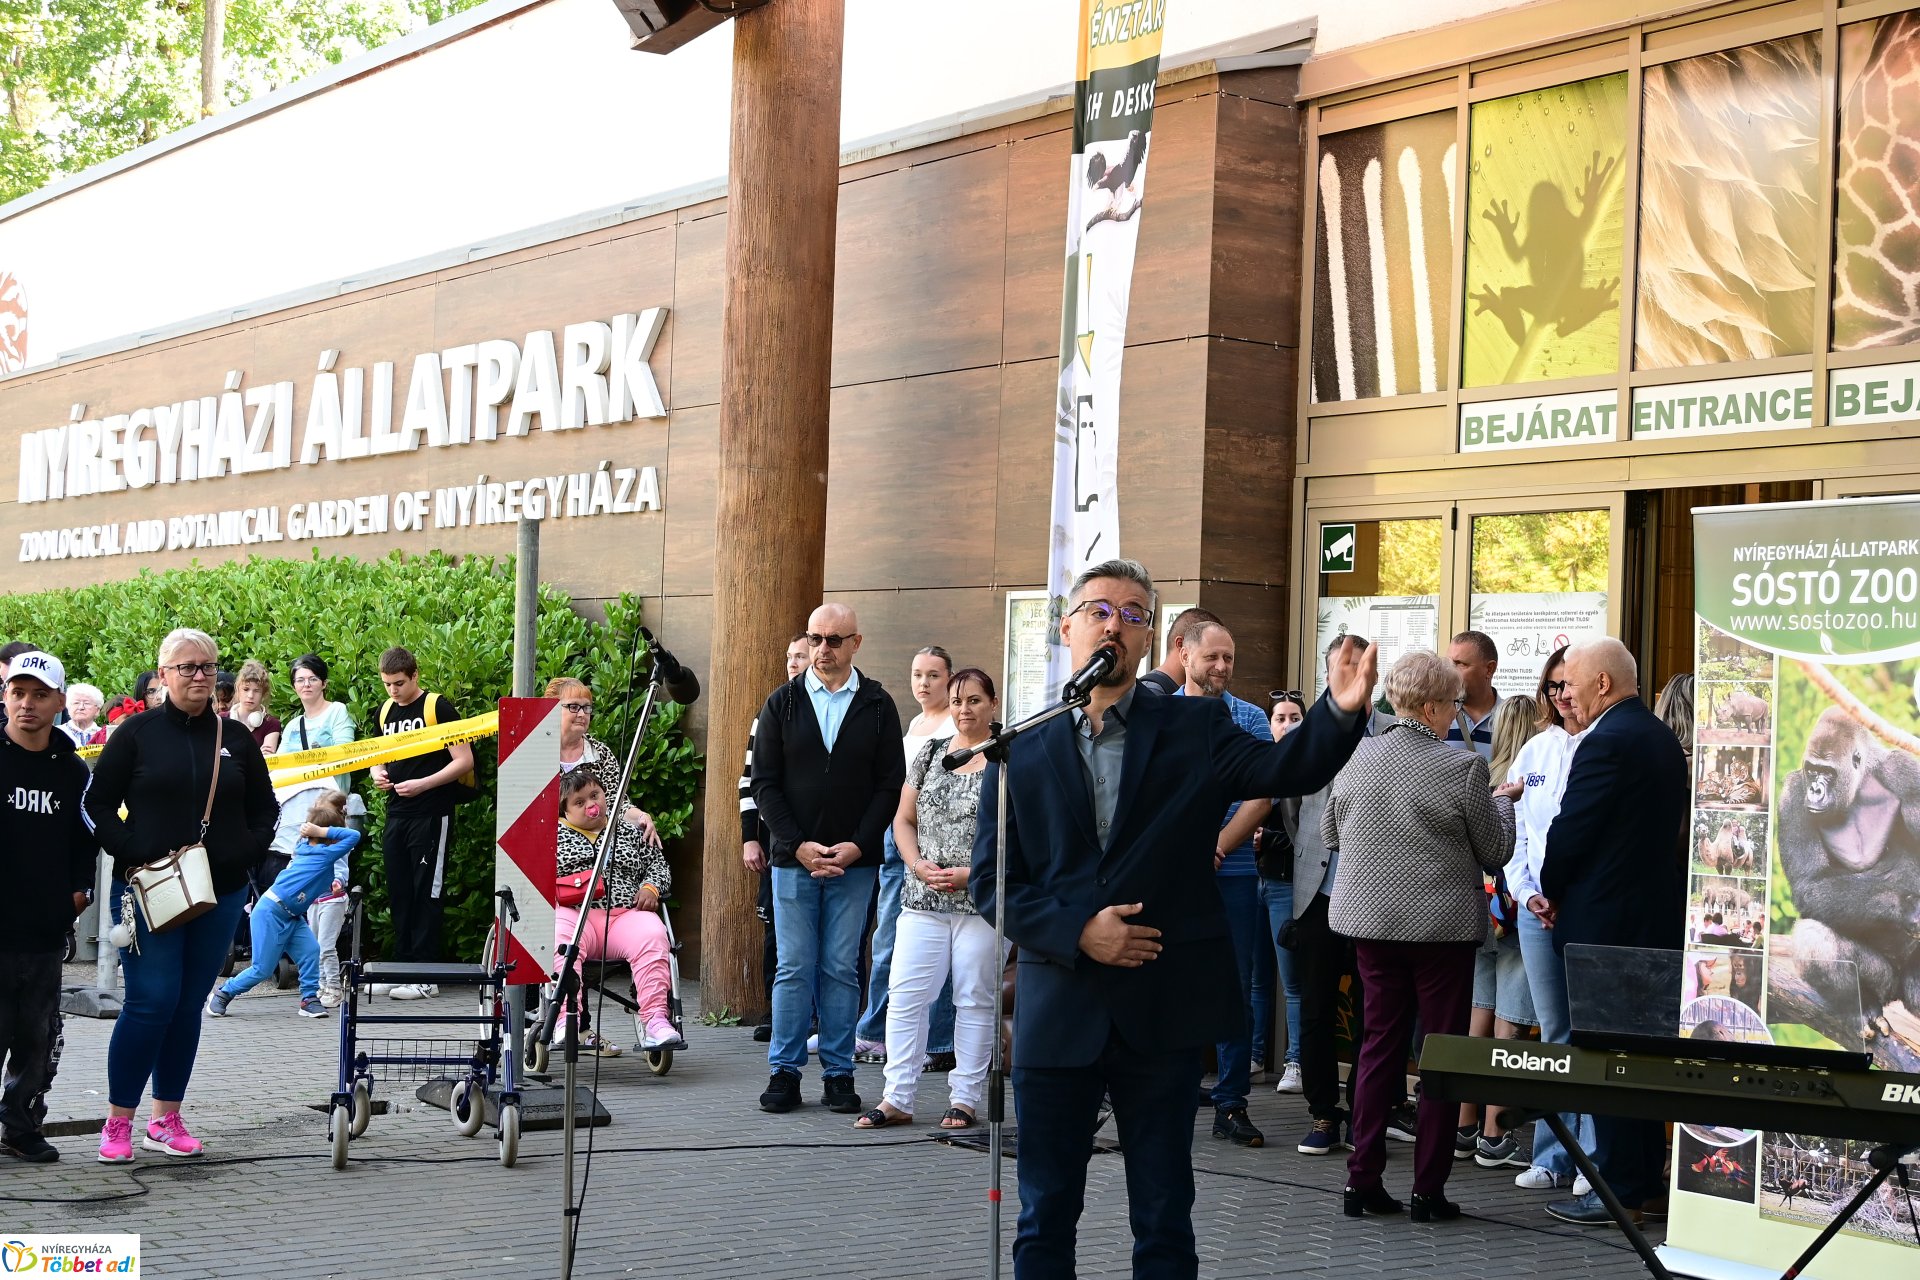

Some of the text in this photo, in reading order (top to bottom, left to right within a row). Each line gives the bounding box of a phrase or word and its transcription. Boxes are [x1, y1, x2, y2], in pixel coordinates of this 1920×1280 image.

[18, 306, 670, 503] NYÍREGYHÁZI ÁLLATPARK
[1464, 402, 1617, 446] BEJÁRAT
[1634, 387, 1813, 433] ENTRANCE
[19, 459, 662, 562] ZOOLOGICAL AND BOTANICAL GARDEN OF NYÍREGYHÁZA
[1733, 537, 1919, 562] NYÍREGYHÁZI ÁLLATPARK
[1731, 559, 1918, 607] SÓSTÓ ZOO
[1730, 606, 1917, 631] www.sostozoo.hu
[384, 717, 424, 735] HUGO
[1526, 774, 1546, 787] 1889
[1490, 1048, 1571, 1074] Roland
